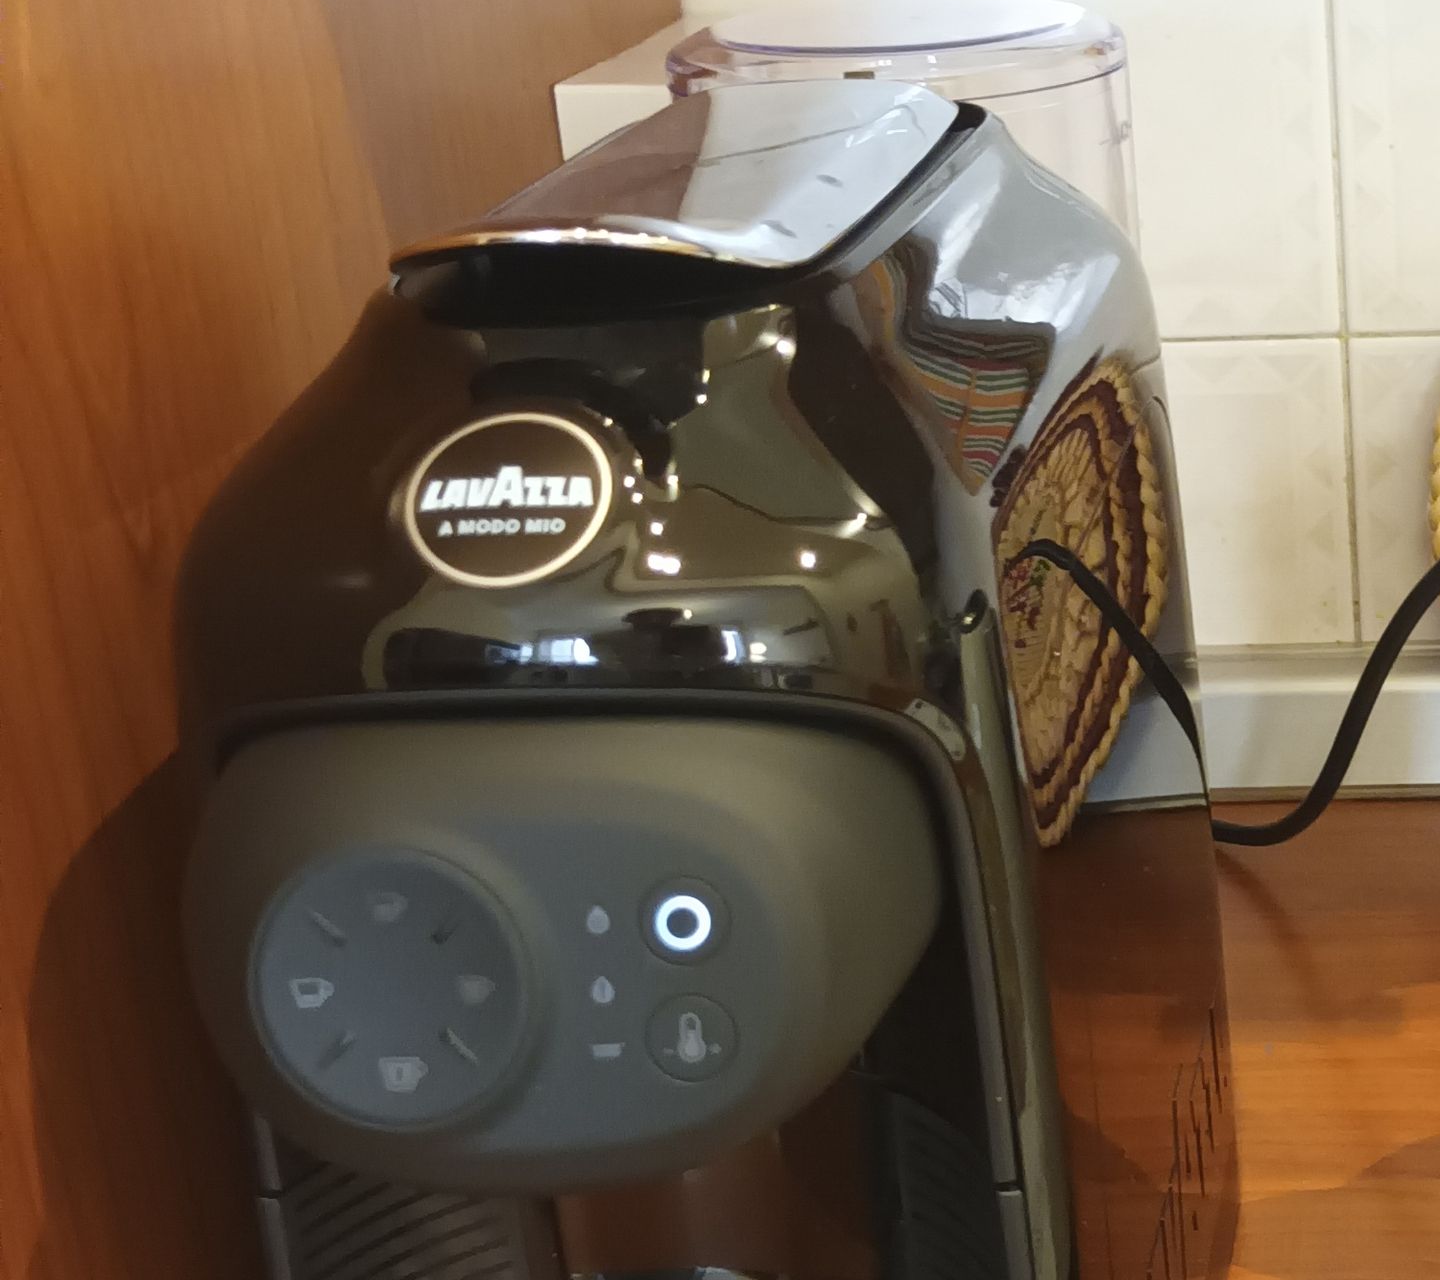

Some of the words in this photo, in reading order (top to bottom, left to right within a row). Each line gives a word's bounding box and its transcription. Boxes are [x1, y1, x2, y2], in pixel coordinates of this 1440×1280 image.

[420, 464, 594, 512] LAVAZZA
[437, 520, 453, 537] A
[457, 518, 521, 536] MODO
[524, 517, 566, 534] MIO
